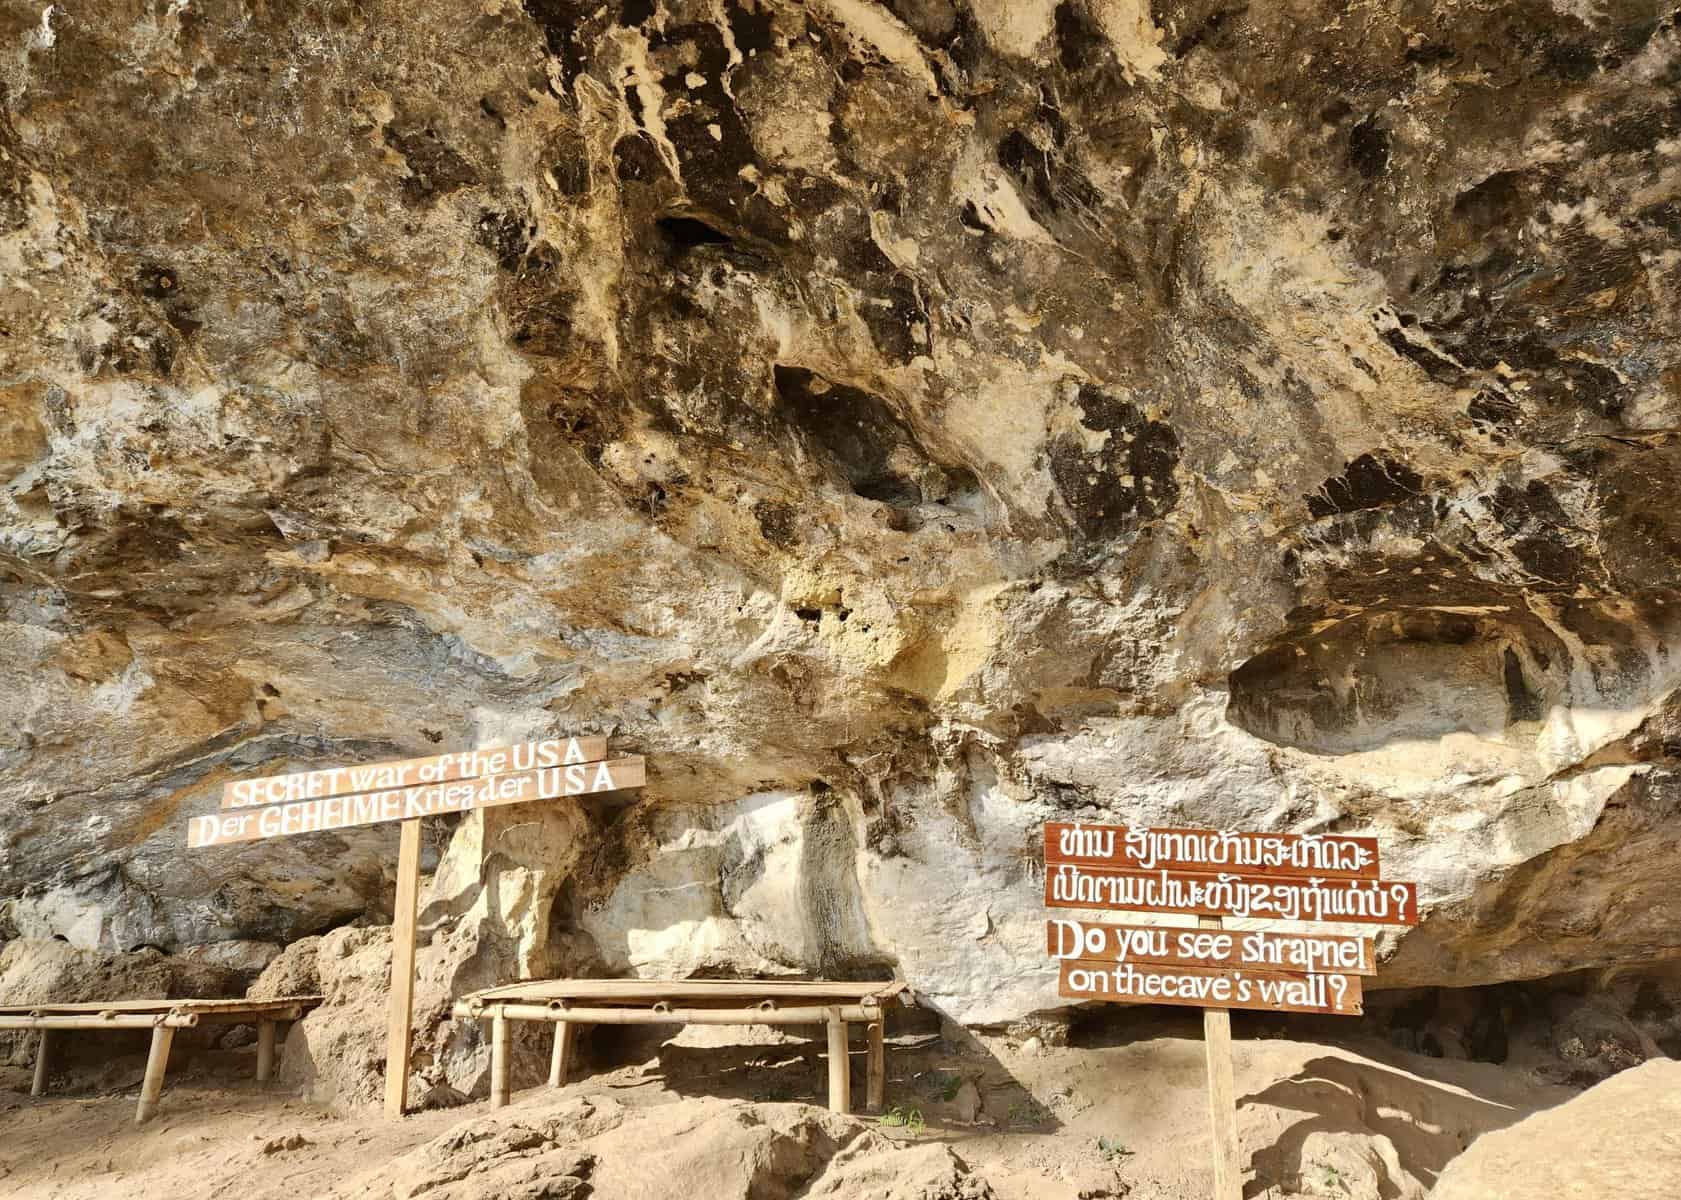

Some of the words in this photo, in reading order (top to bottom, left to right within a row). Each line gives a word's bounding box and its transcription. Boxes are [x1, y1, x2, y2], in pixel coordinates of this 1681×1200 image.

[199, 812, 256, 846] Der
[477, 775, 533, 802] der
[537, 760, 617, 800] USA
[230, 766, 350, 808] SECRET
[351, 763, 412, 791] war
[418, 752, 457, 782] of
[458, 749, 507, 778] the
[513, 737, 587, 770] USA
[1051, 919, 1107, 960] Do
[1116, 927, 1169, 961] you
[1177, 933, 1233, 960] see
[1241, 932, 1369, 971] shrapnel
[1068, 967, 1109, 994] on
[1257, 973, 1348, 1010] wall?
